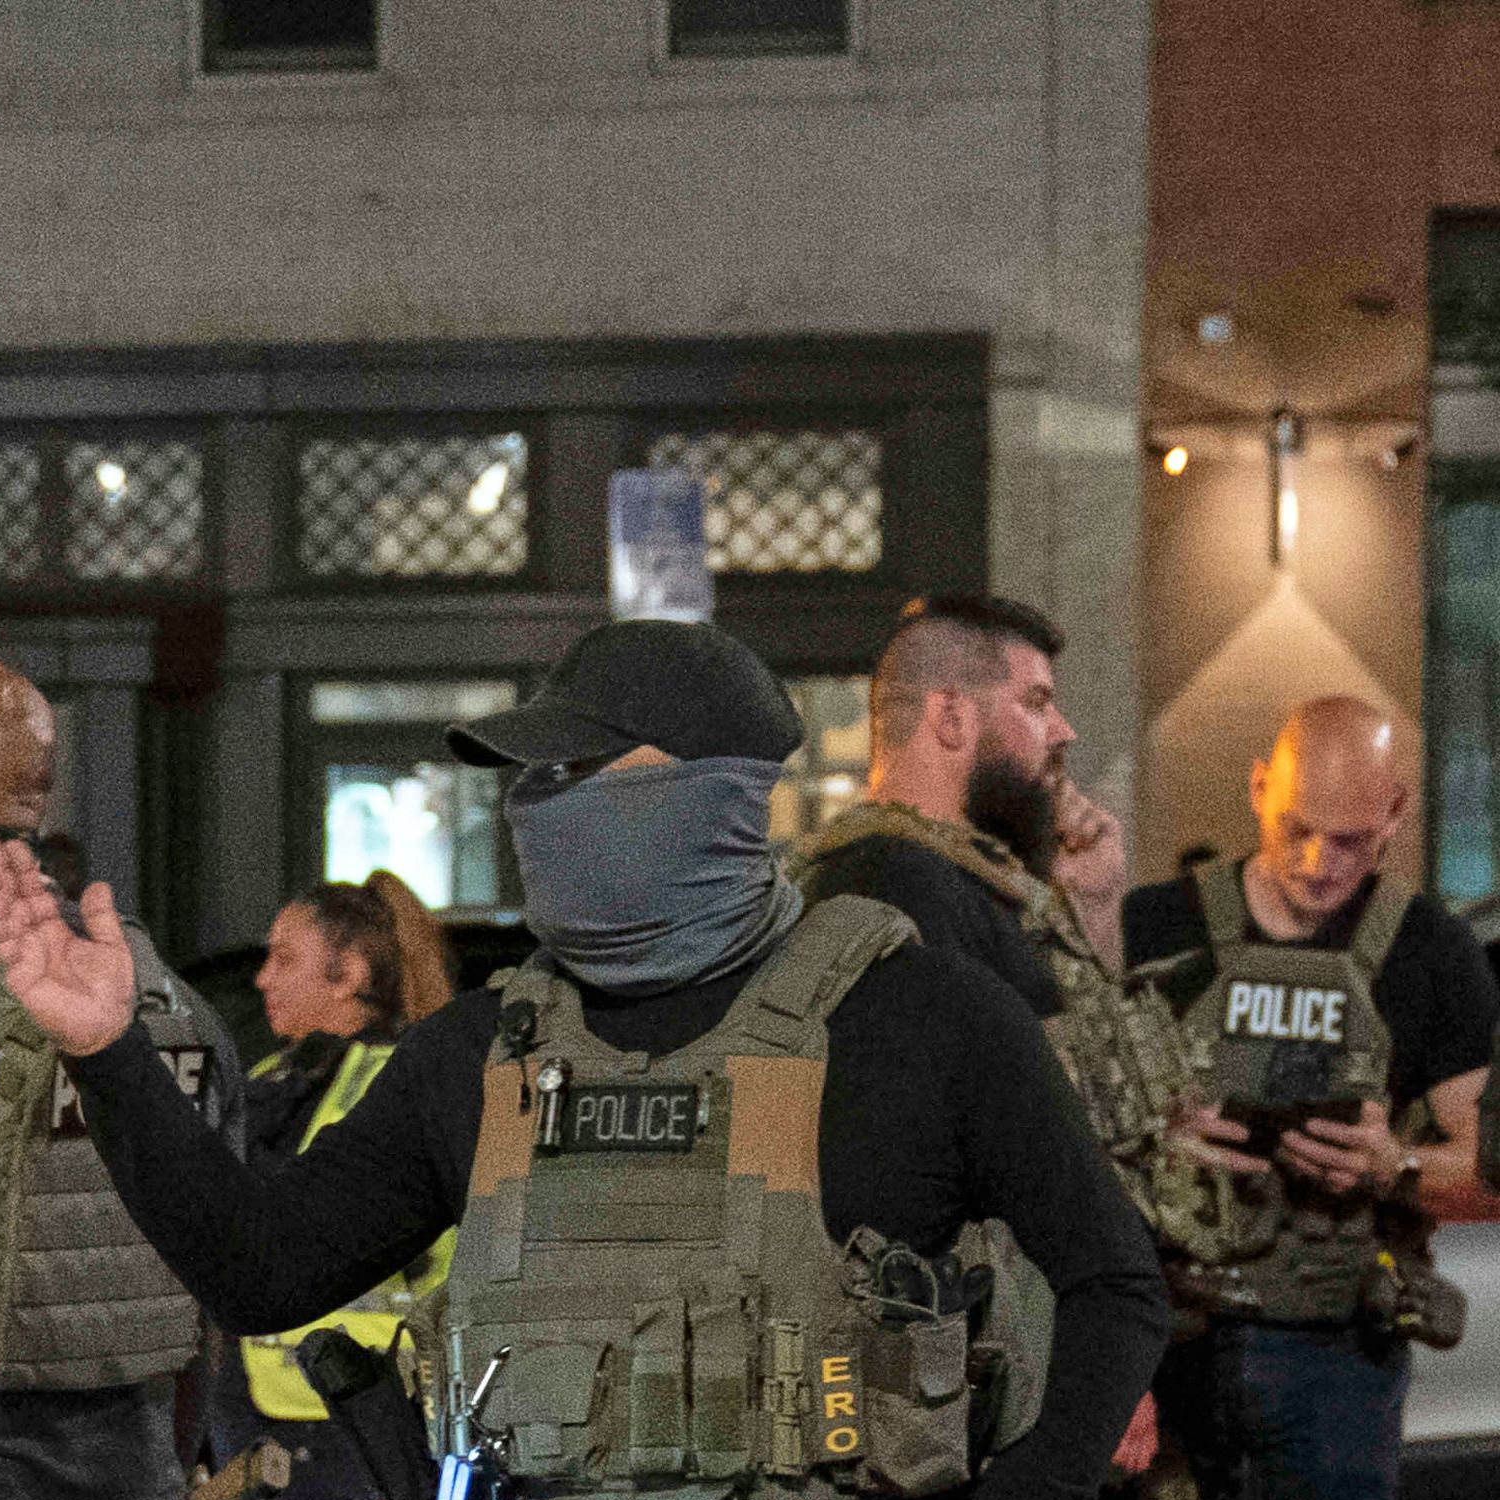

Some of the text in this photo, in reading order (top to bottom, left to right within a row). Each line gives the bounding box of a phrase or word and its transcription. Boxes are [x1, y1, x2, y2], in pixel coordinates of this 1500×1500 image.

[1225, 979, 1347, 1042] POLICE
[575, 1095, 689, 1141] POLICE
[821, 1356, 859, 1453] ERO
